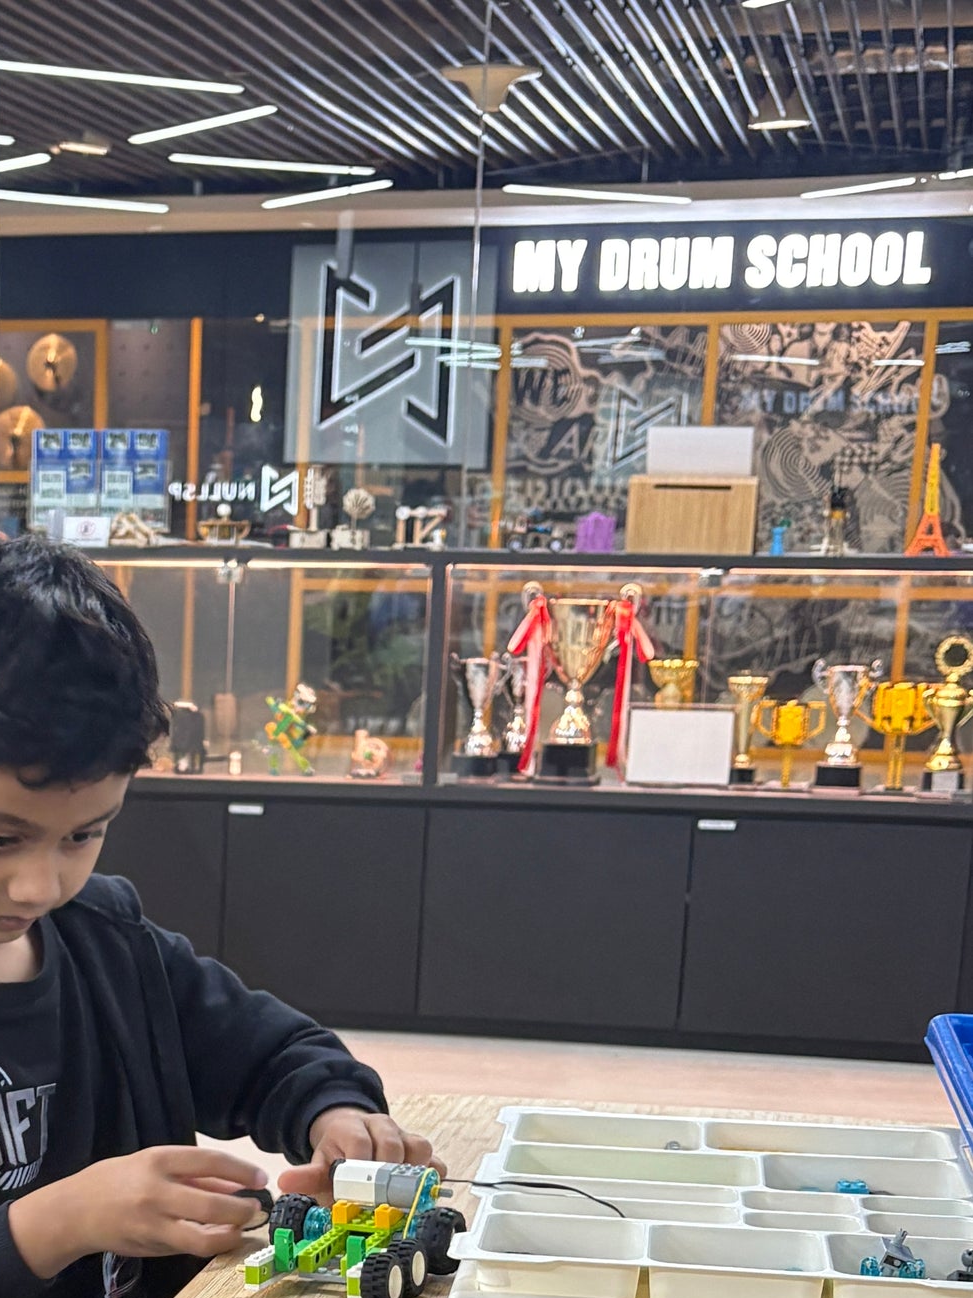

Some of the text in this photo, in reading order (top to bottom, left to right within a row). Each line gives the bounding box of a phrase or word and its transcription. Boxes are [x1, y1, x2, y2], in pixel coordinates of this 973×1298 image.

[513, 230, 932, 293] MY DRUM SCHOOL
